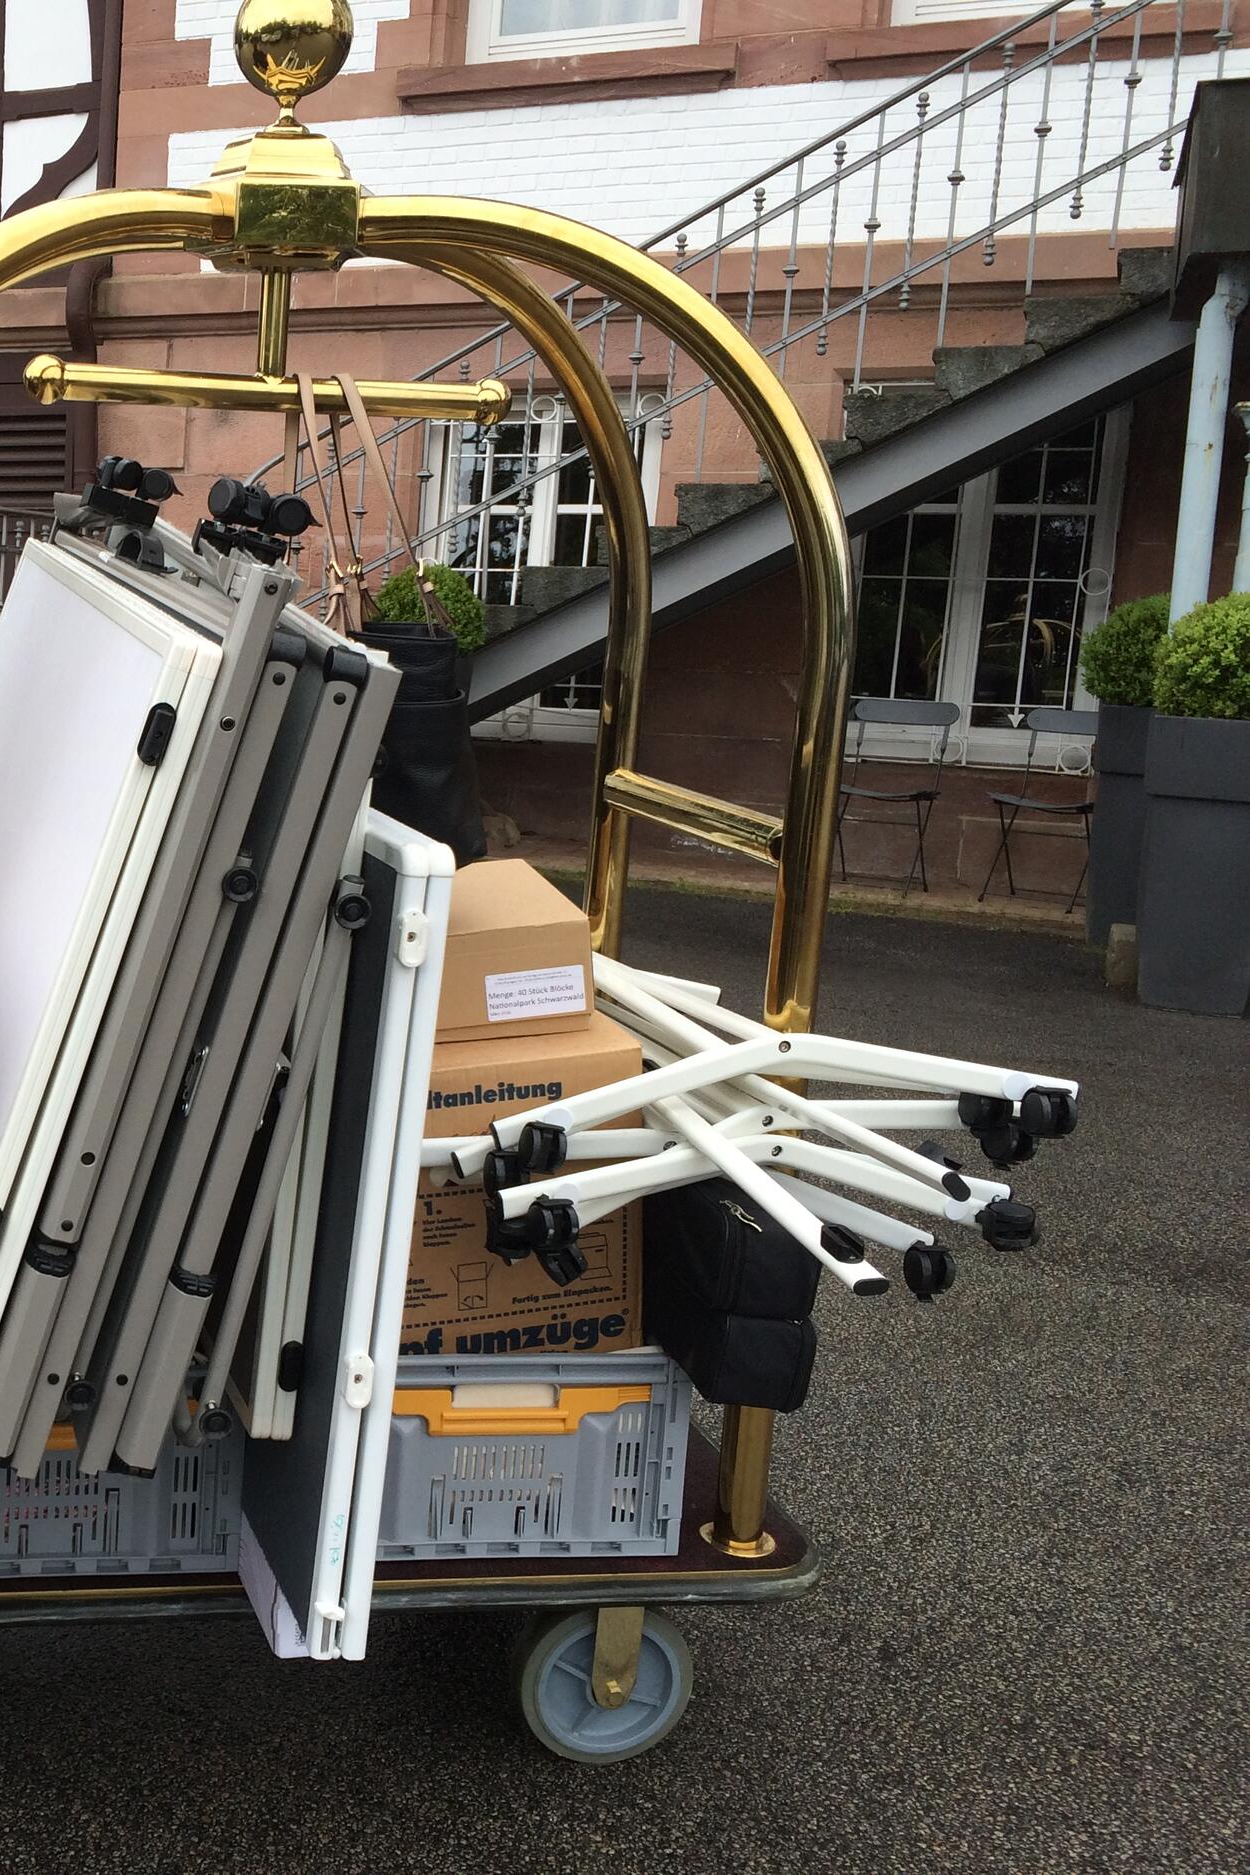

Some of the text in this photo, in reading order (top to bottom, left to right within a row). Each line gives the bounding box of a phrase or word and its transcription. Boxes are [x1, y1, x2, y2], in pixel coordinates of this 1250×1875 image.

[528, 986, 548, 996] Stück
[550, 984, 574, 993] Blöcke
[488, 992, 584, 1011] Nationalpark Schwarzwald
[512, 1294, 540, 1304] Fertig
